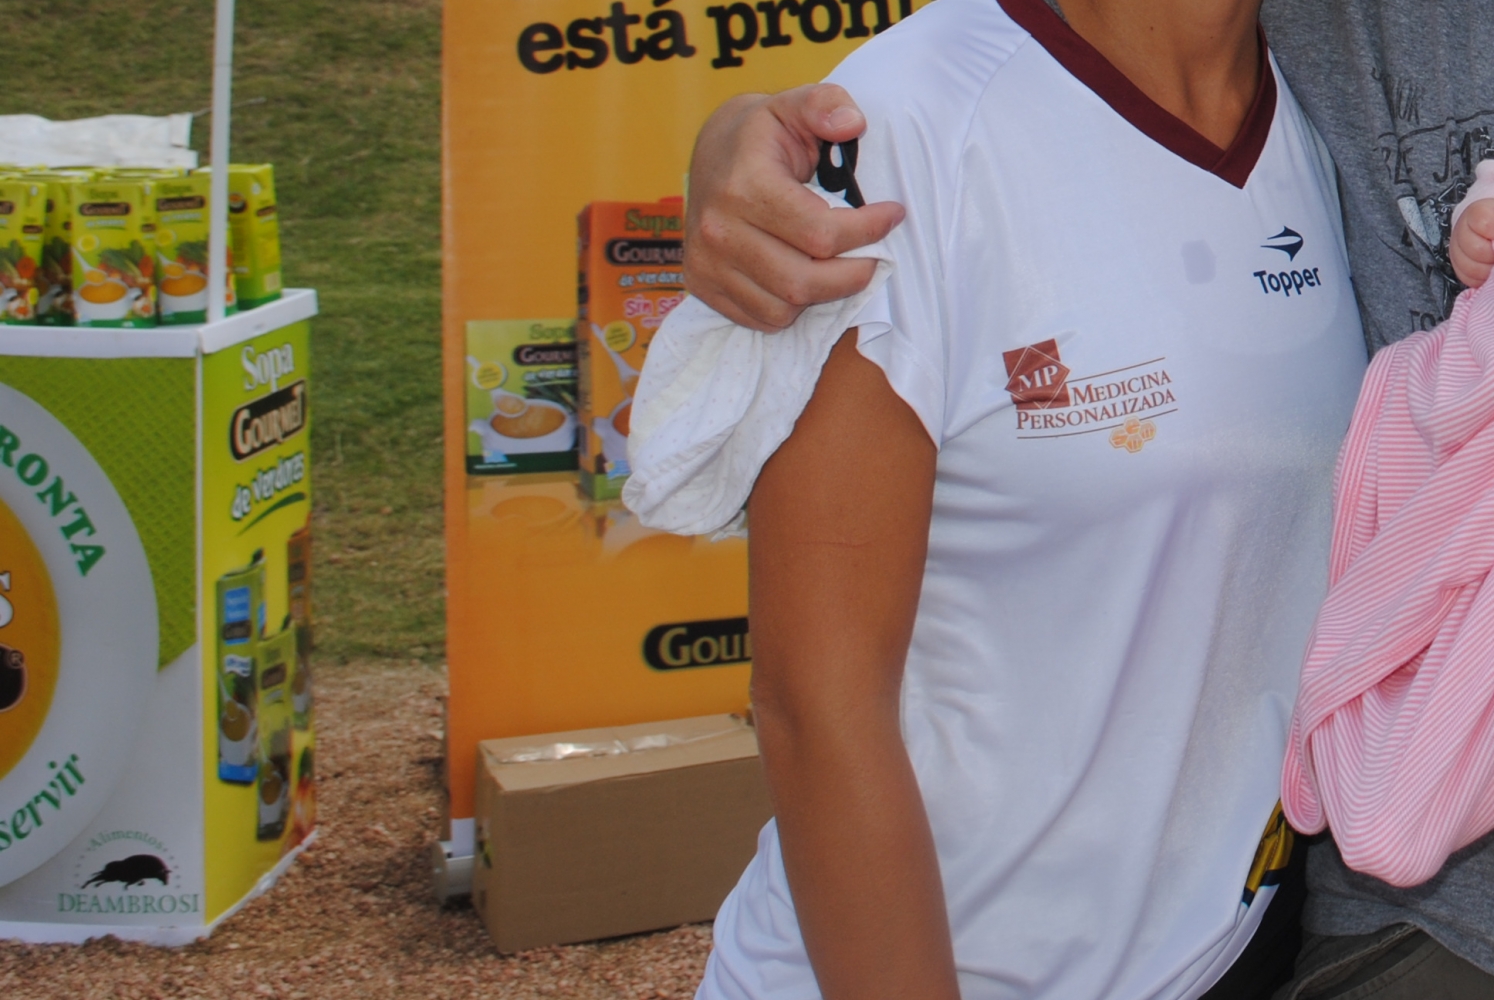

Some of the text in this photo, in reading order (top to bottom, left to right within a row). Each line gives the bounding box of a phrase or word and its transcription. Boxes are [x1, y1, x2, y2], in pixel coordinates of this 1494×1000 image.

[625, 208, 682, 237] Sopa
[1253, 266, 1322, 297] Topper
[624, 294, 654, 318] sin
[241, 342, 296, 393] Sopa
[1017, 364, 1060, 393] MP
[1070, 369, 1173, 407] MEDICINA
[1016, 389, 1177, 431] PERSONALIZADA
[89, 828, 164, 850] Alimentos
[57, 893, 200, 914] DEAMBROSI
